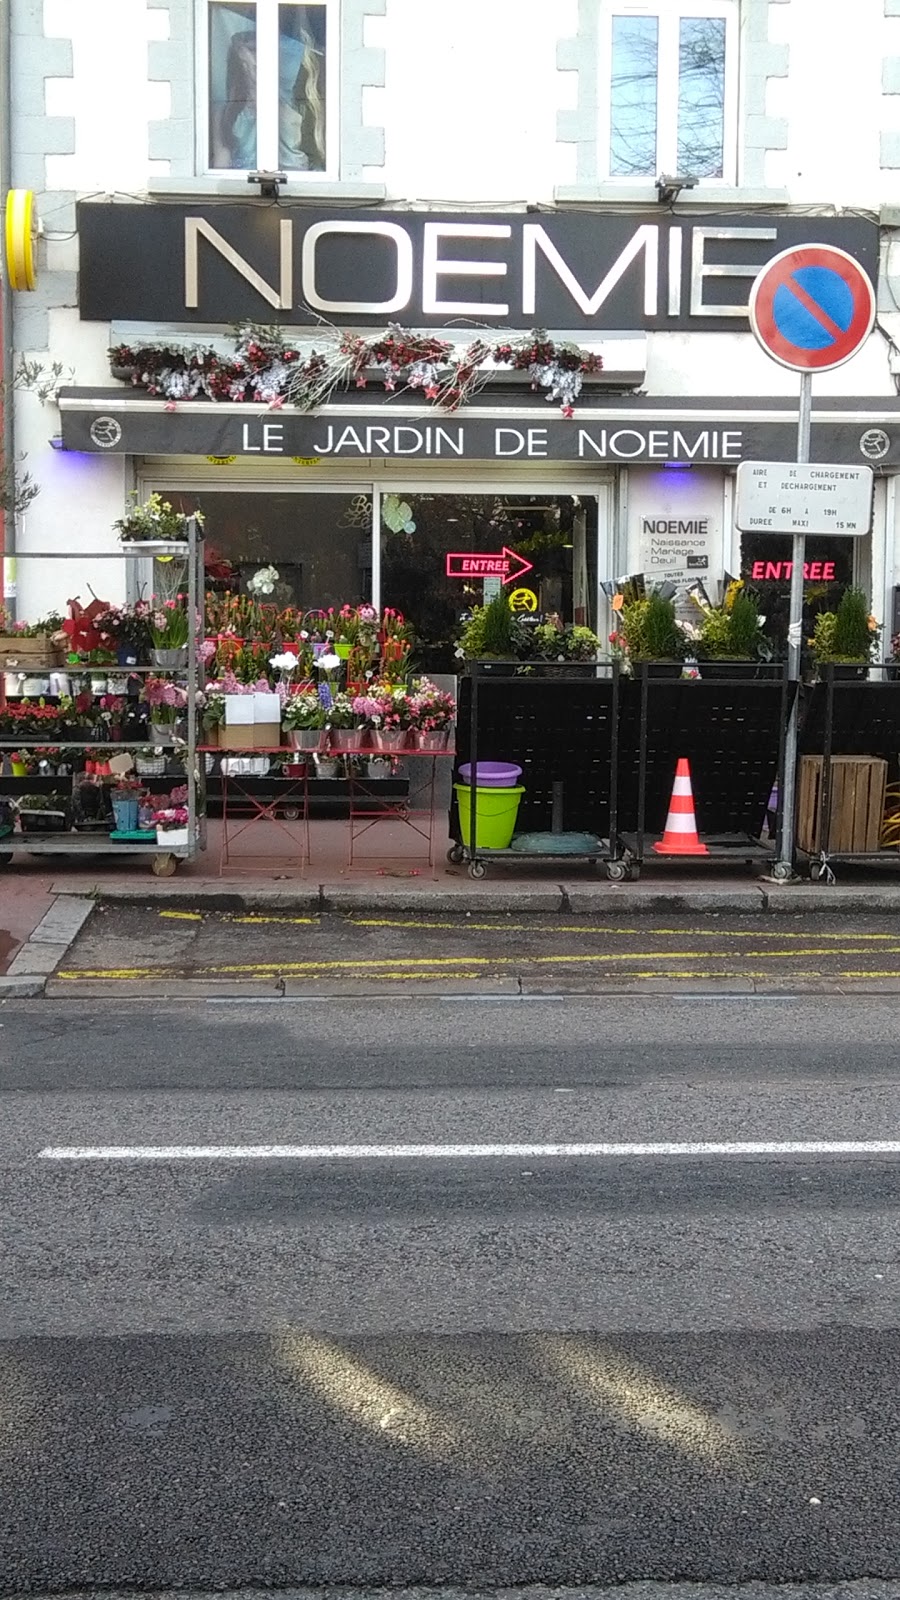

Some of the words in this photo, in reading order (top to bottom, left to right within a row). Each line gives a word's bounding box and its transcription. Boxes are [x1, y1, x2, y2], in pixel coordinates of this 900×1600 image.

[183, 216, 777, 317] NOEMIE
[242, 422, 284, 453] LE
[312, 424, 466, 457] JARDIN
[494, 427, 548, 456] DE
[577, 428, 743, 460] NOEMIE
[752, 469, 768, 477] AIRE
[789, 470, 797, 478] DE
[810, 471, 860, 480] CHARGEMENT
[780, 483, 837, 491] DECHARGEMENT
[781, 507, 792, 515] 6H
[643, 520, 708, 534] NOEMIE
[749, 518, 773, 526] DUREE
[836, 521, 845, 529] 15
[652, 548, 693, 556] Mariage
[462, 560, 510, 571] ENTREE
